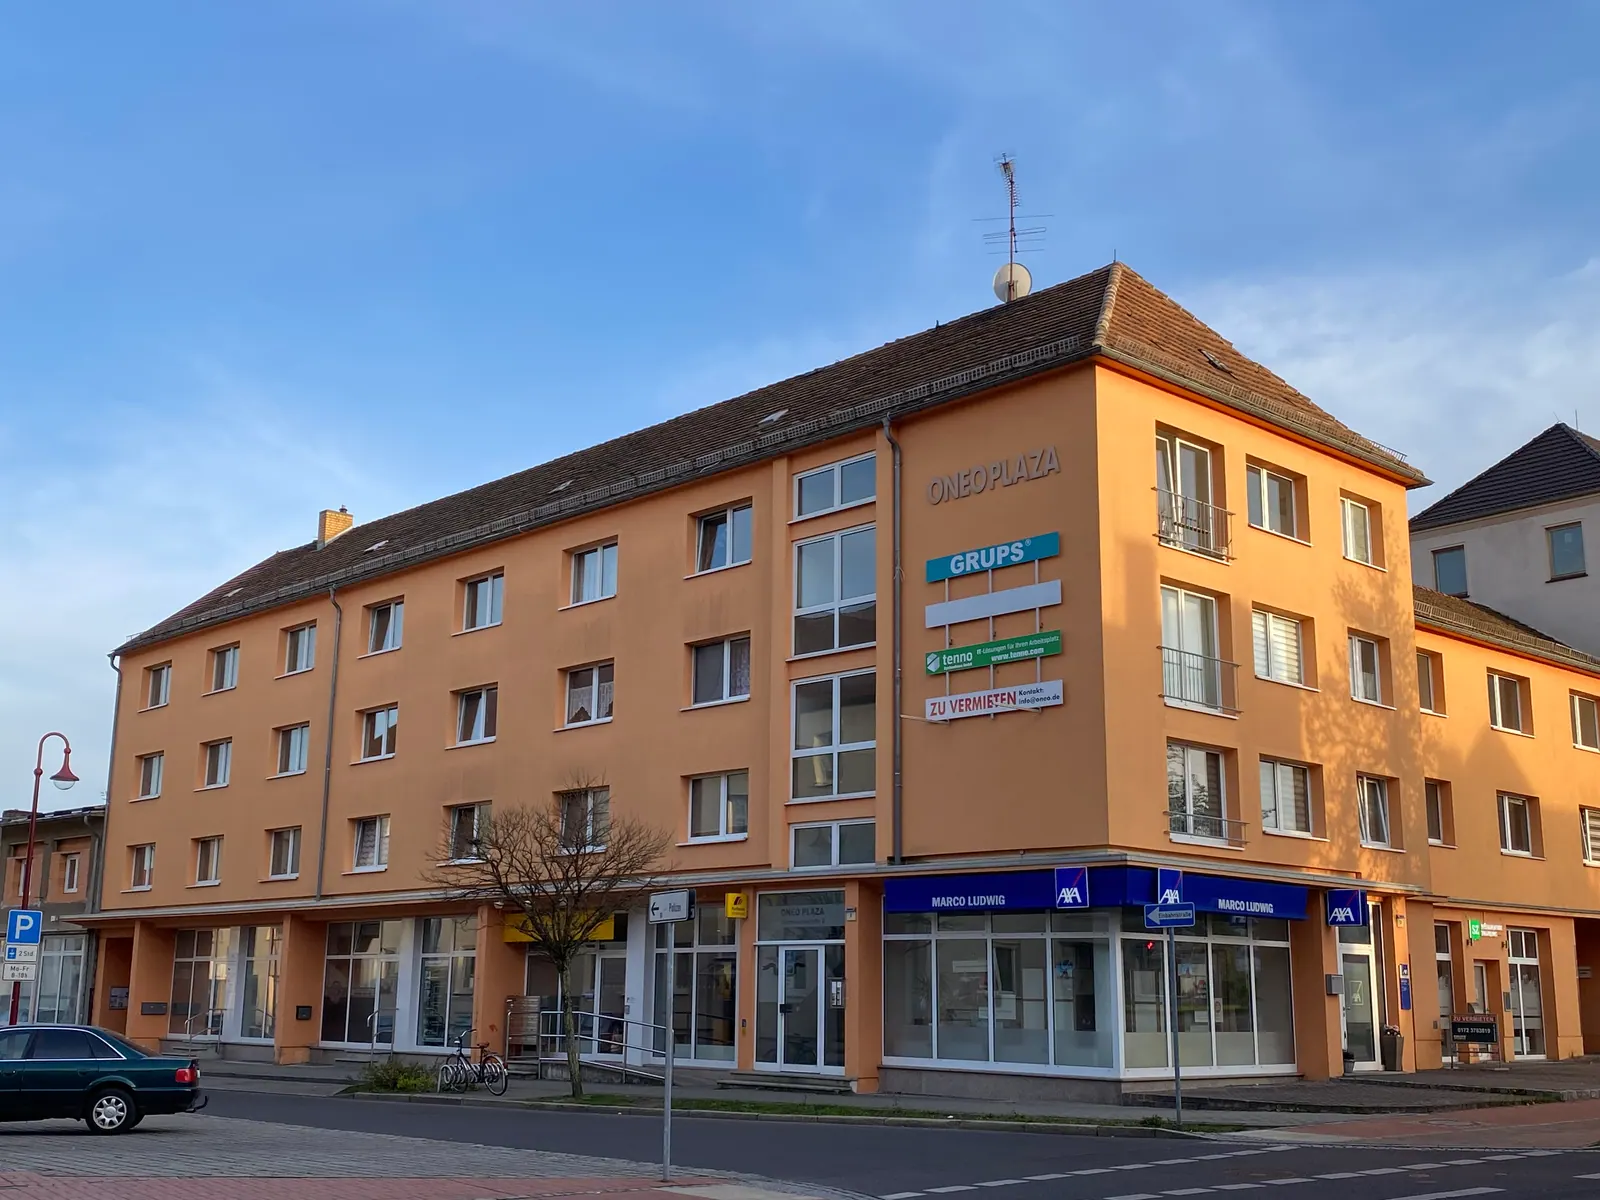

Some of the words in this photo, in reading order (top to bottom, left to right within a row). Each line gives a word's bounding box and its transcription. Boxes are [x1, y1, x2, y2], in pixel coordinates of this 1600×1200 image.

[942, 651, 973, 666] tenno
[991, 647, 1045, 662] www.tenno.com
[930, 701, 946, 717] ZU
[950, 690, 1017, 714] VERMIETEN
[932, 896, 966, 908] MARCO
[967, 895, 1006, 906] LUDWIG
[1056, 887, 1082, 904] AXA
[1159, 889, 1180, 904] AXA
[801, 907, 825, 916] PLAZA
[1218, 899, 1245, 911] MARCO
[1246, 901, 1274, 914] LUDWIG
[1329, 907, 1355, 922] AXA
[14, 914, 34, 940] P
